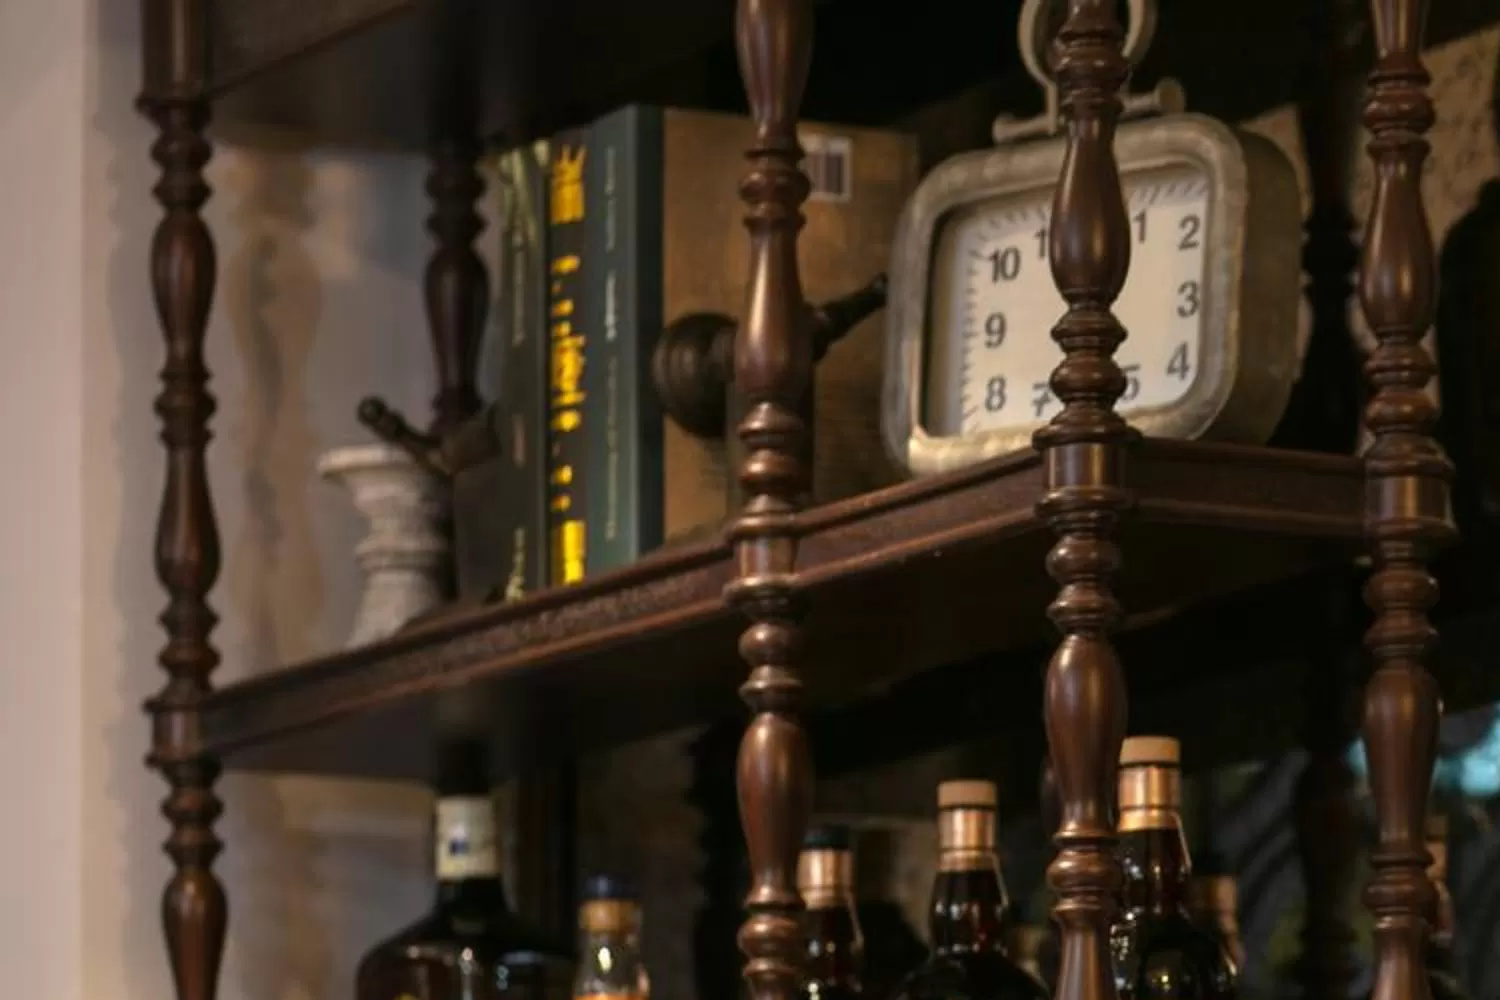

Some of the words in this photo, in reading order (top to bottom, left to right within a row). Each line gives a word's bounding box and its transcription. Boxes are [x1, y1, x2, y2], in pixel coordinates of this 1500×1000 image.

[1034, 227, 1049, 259] 1
[1134, 210, 1147, 244] 1
[1178, 214, 1200, 250] 2
[988, 247, 1021, 283] 10
[1177, 281, 1200, 318] 3
[985, 312, 1007, 349] 9
[1166, 341, 1190, 381] 4
[985, 374, 1006, 412] 8
